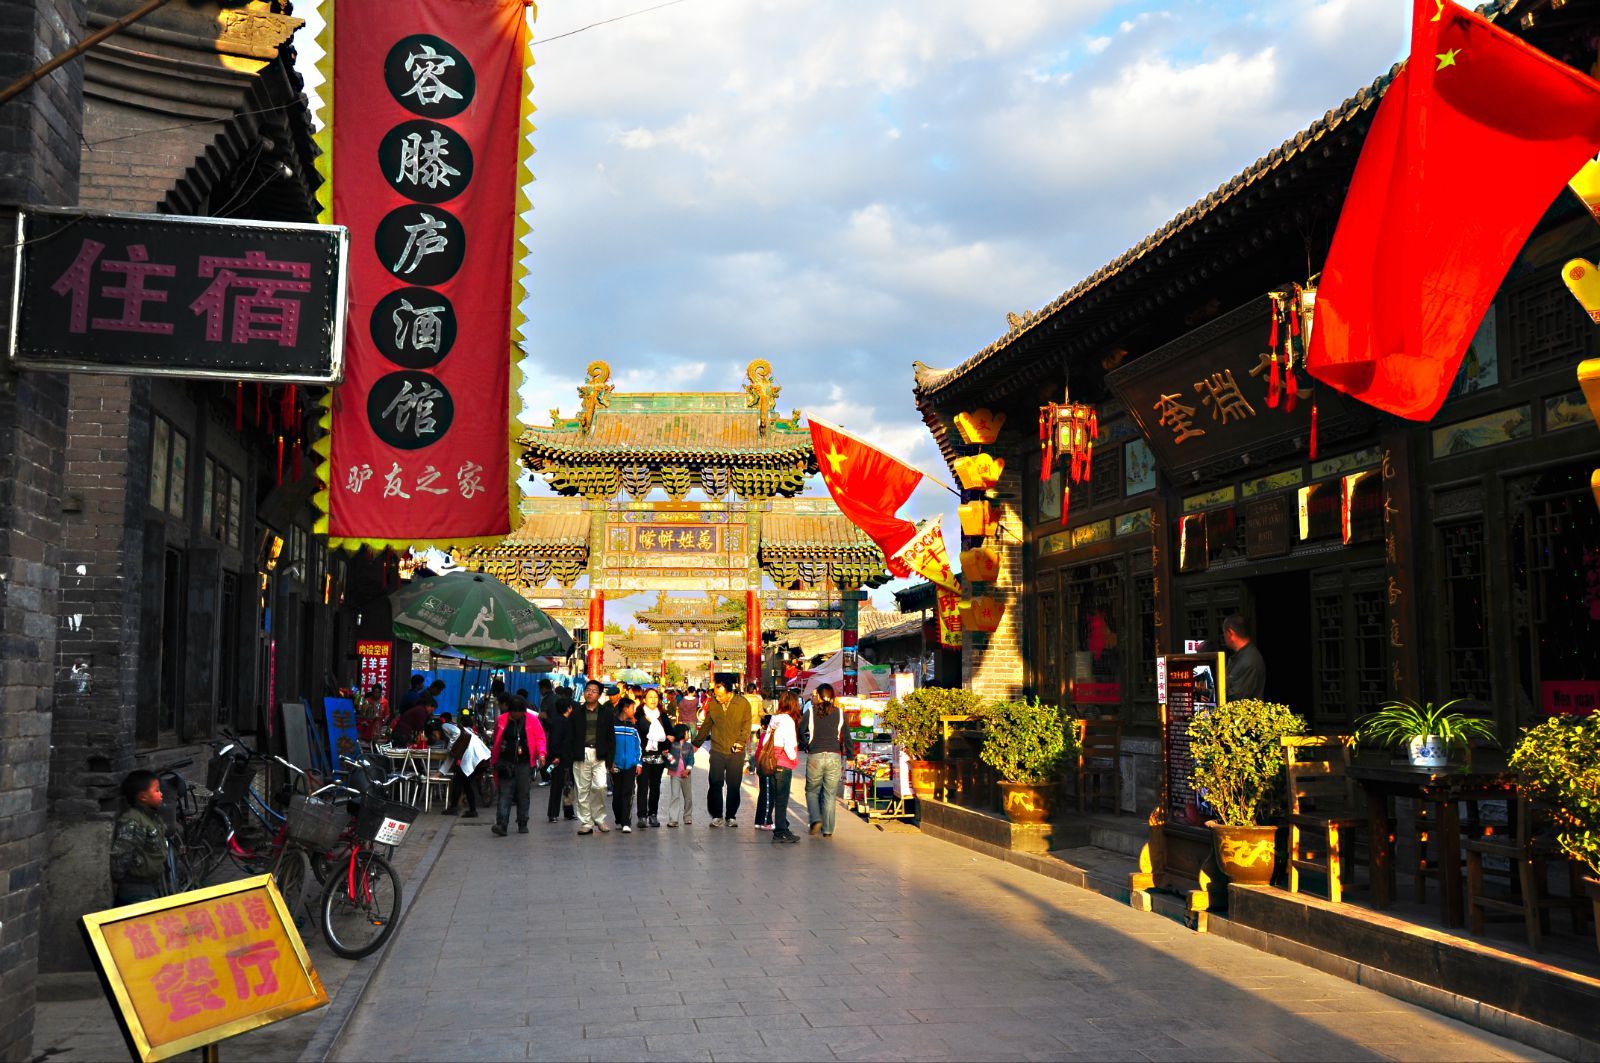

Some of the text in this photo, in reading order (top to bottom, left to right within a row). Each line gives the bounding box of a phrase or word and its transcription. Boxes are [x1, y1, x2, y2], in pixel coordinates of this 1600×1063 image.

[382, 43, 464, 437] 容膝庐酒馆
[51, 237, 312, 347] 住宿
[345, 459, 487, 499] 驴友之家
[358, 644, 389, 656] 内设空调
[124, 896, 271, 959] 旅游网推荐
[151, 938, 281, 1022] 餐厅
